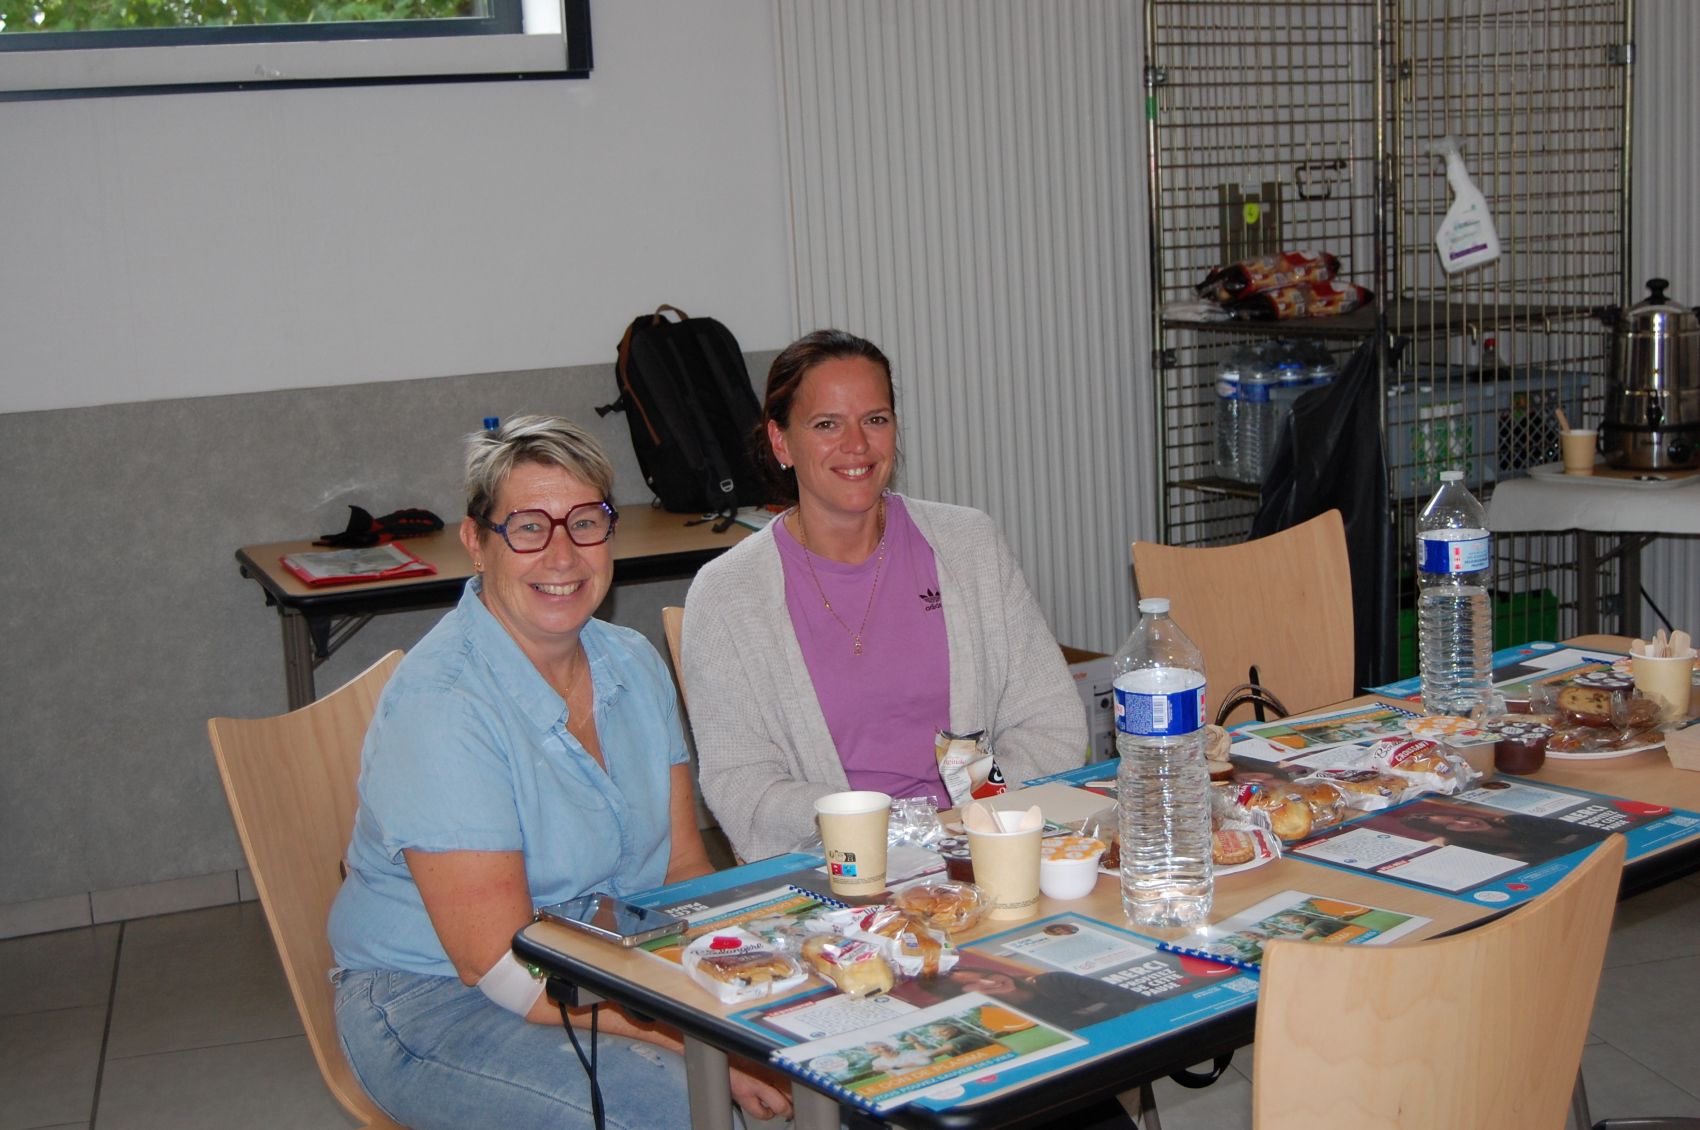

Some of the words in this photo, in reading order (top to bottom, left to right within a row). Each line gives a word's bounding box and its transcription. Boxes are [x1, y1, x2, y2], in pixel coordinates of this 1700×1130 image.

[1559, 805, 1609, 822] MERCI
[1102, 960, 1169, 984] MERCI
[1118, 968, 1177, 989] PROFITEZ
[1130, 983, 1147, 993] DE
[1147, 974, 1184, 988] CETTE
[1140, 983, 1182, 997] PAUSE
